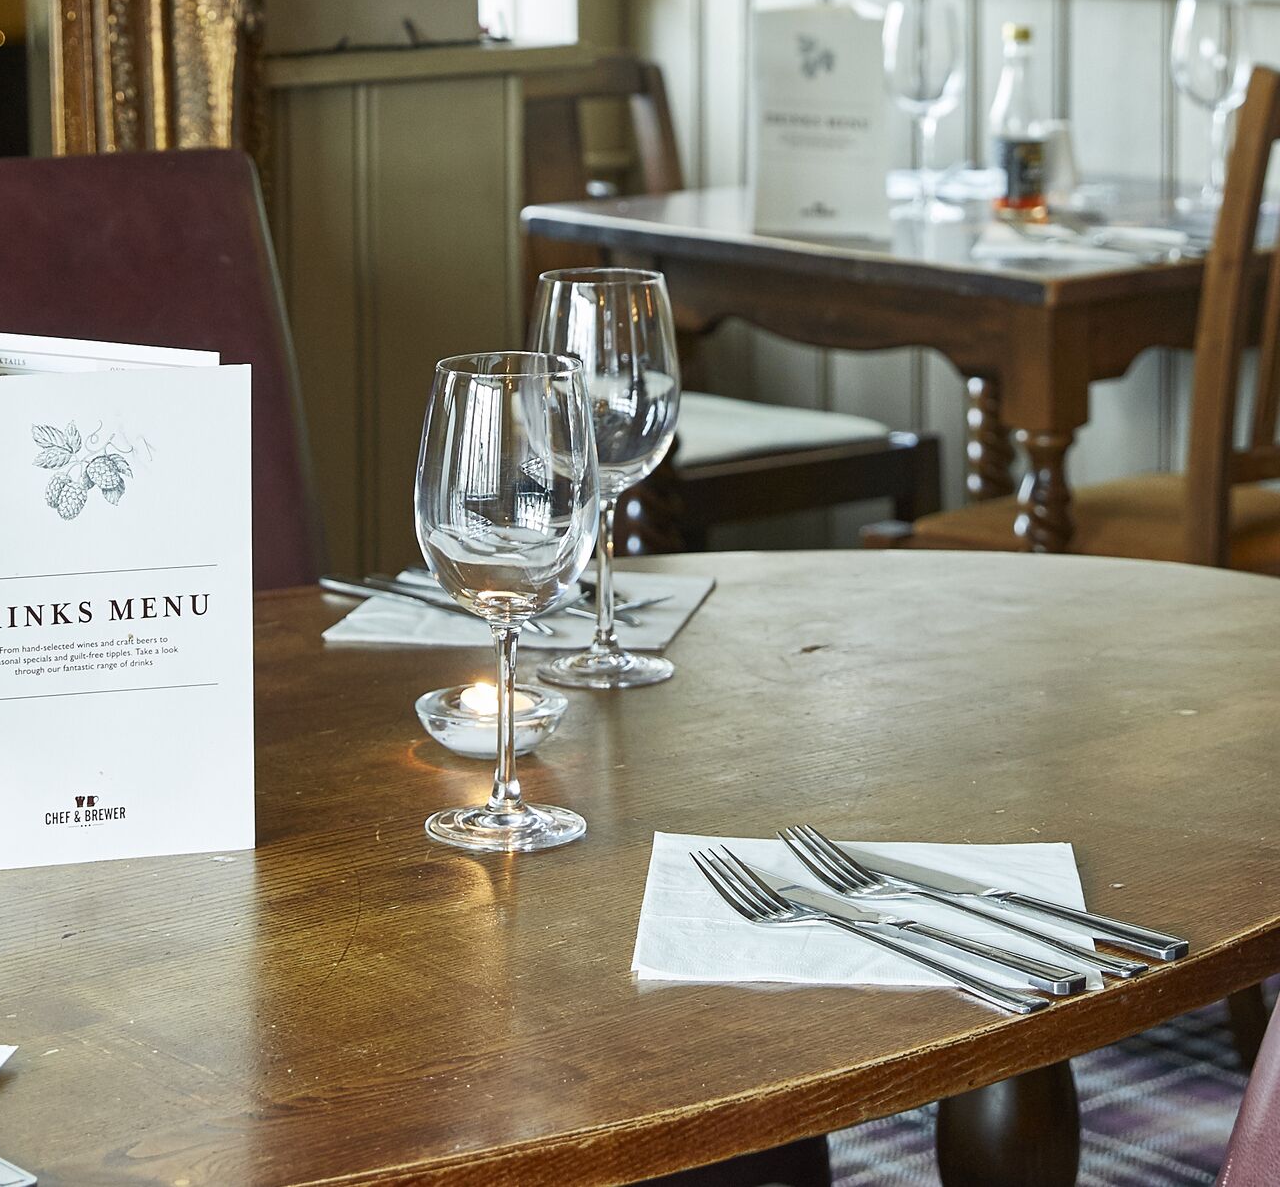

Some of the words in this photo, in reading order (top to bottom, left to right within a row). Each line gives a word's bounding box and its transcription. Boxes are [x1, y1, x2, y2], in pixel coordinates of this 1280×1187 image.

[109, 594, 210, 621] MENU
[0, 646, 20, 654] From
[22, 642, 75, 652] hand-selected
[77, 640, 98, 649] wines
[100, 638, 115, 648] and
[116, 635, 134, 647] craft
[136, 636, 157, 645] beers
[159, 636, 168, 644] to
[23, 655, 52, 665] specials
[54, 653, 68, 662] and
[69, 650, 104, 662] guilt-free
[106, 648, 132, 659] tipples.
[135, 647, 153, 656] Take
[161, 645, 179, 655] look
[14, 667, 45, 675] through
[63, 661, 95, 672] fantastic
[96, 661, 118, 671] range
[119, 659, 129, 668] of
[130, 659, 154, 667] drinks
[45, 811, 70, 825] CHEF
[74, 810, 81, 823] &
[84, 806, 126, 822] BREWER
